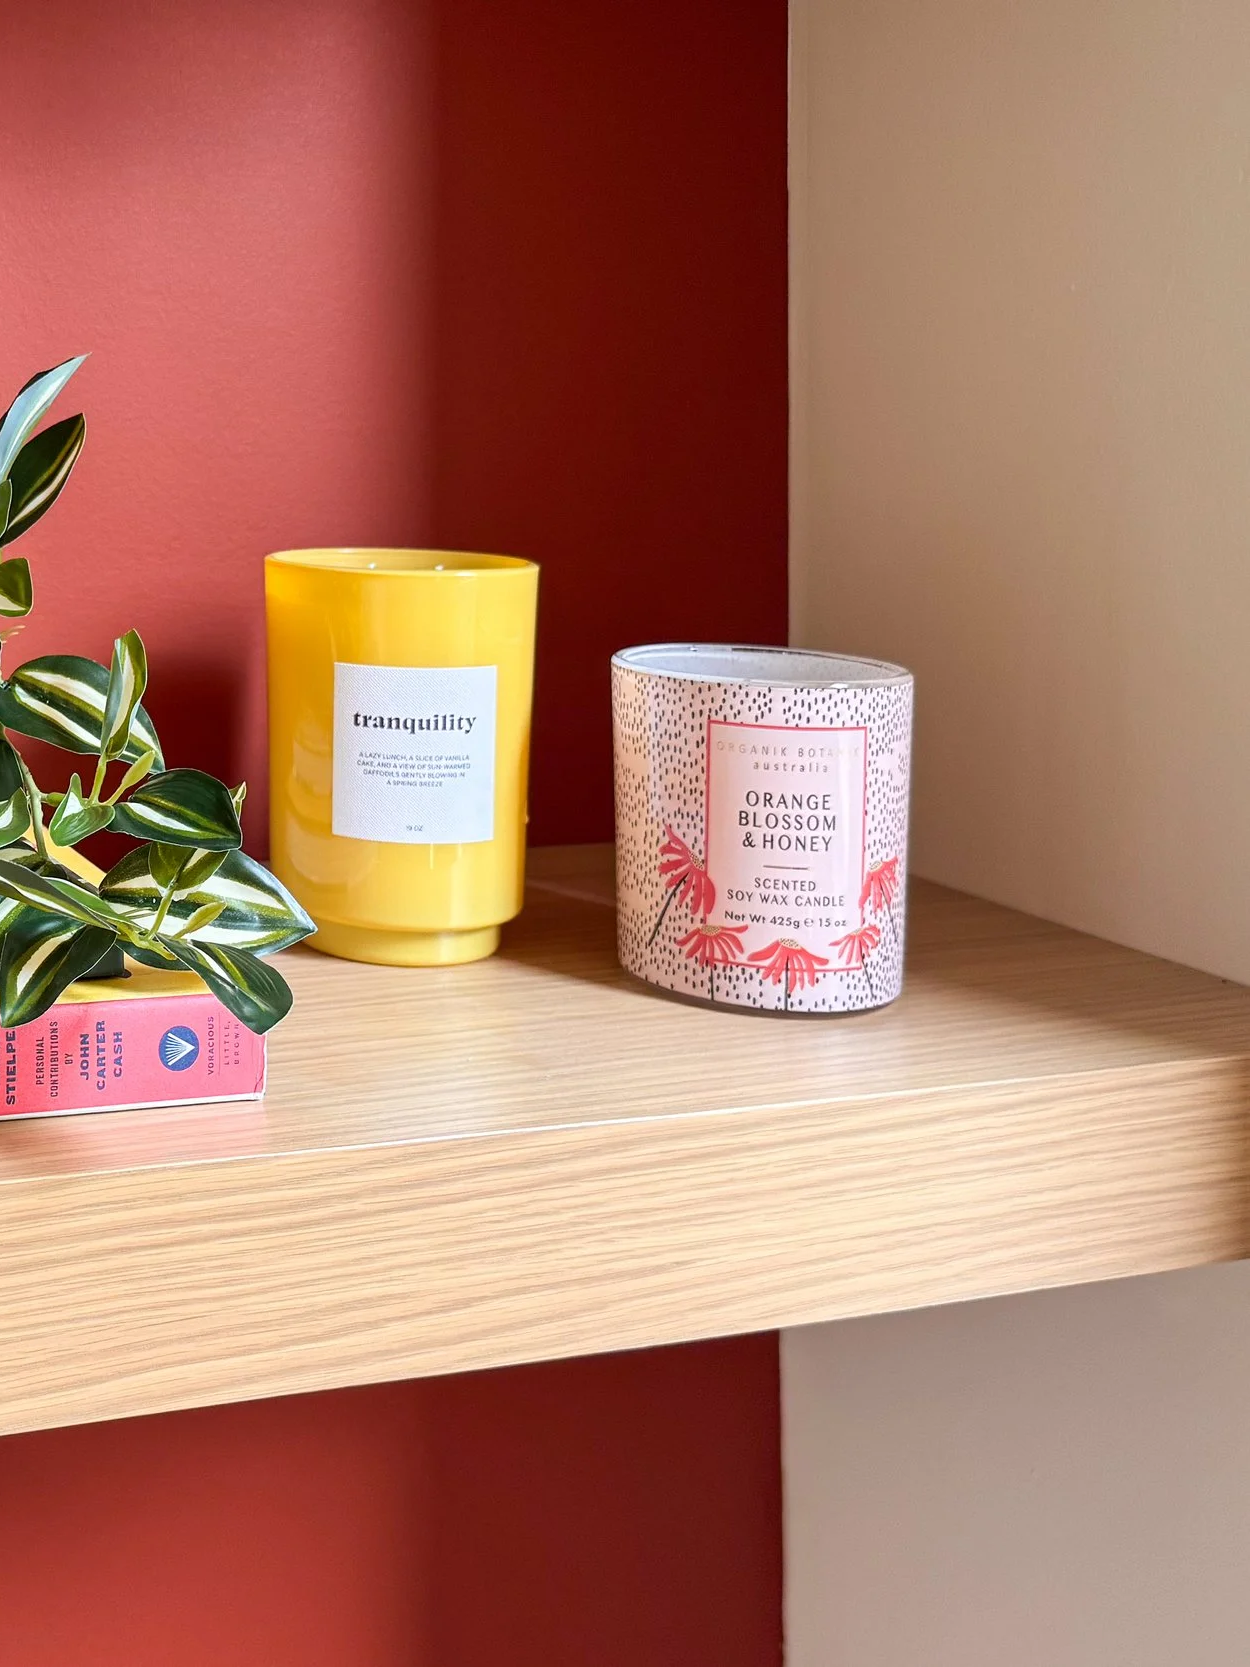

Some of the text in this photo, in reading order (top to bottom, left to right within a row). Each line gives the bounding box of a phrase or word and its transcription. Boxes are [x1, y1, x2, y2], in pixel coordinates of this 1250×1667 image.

[352, 711, 476, 734] tranquility
[382, 753, 407, 761] LUNCH,
[716, 740, 787, 757] ORGANIK
[357, 760, 375, 768] CAKE,
[363, 769, 400, 778] DAFFODILS
[753, 761, 829, 773] australia
[745, 790, 831, 811] ORANGE
[738, 811, 836, 831] BLOSSOM
[742, 832, 832, 852] & HONEY
[754, 877, 816, 892] SCENTED
[727, 889, 845, 907] SOY WAX CANDLE
[724, 910, 746, 922] Net
[749, 914, 766, 924] Wt
[770, 916, 800, 929] 425g
[819, 918, 831, 927] 15
[834, 919, 847, 927] oz
[36, 1037, 44, 1085] PERSONAL
[50, 1021, 58, 1097] CONTRIBUTIONS
[65, 1053, 73, 1065] BY
[80, 1034, 89, 1080] JOHN
[96, 1021, 106, 1090] CARTER
[113, 1032, 122, 1077] CASH
[6, 1031, 17, 1105] STIELPE
